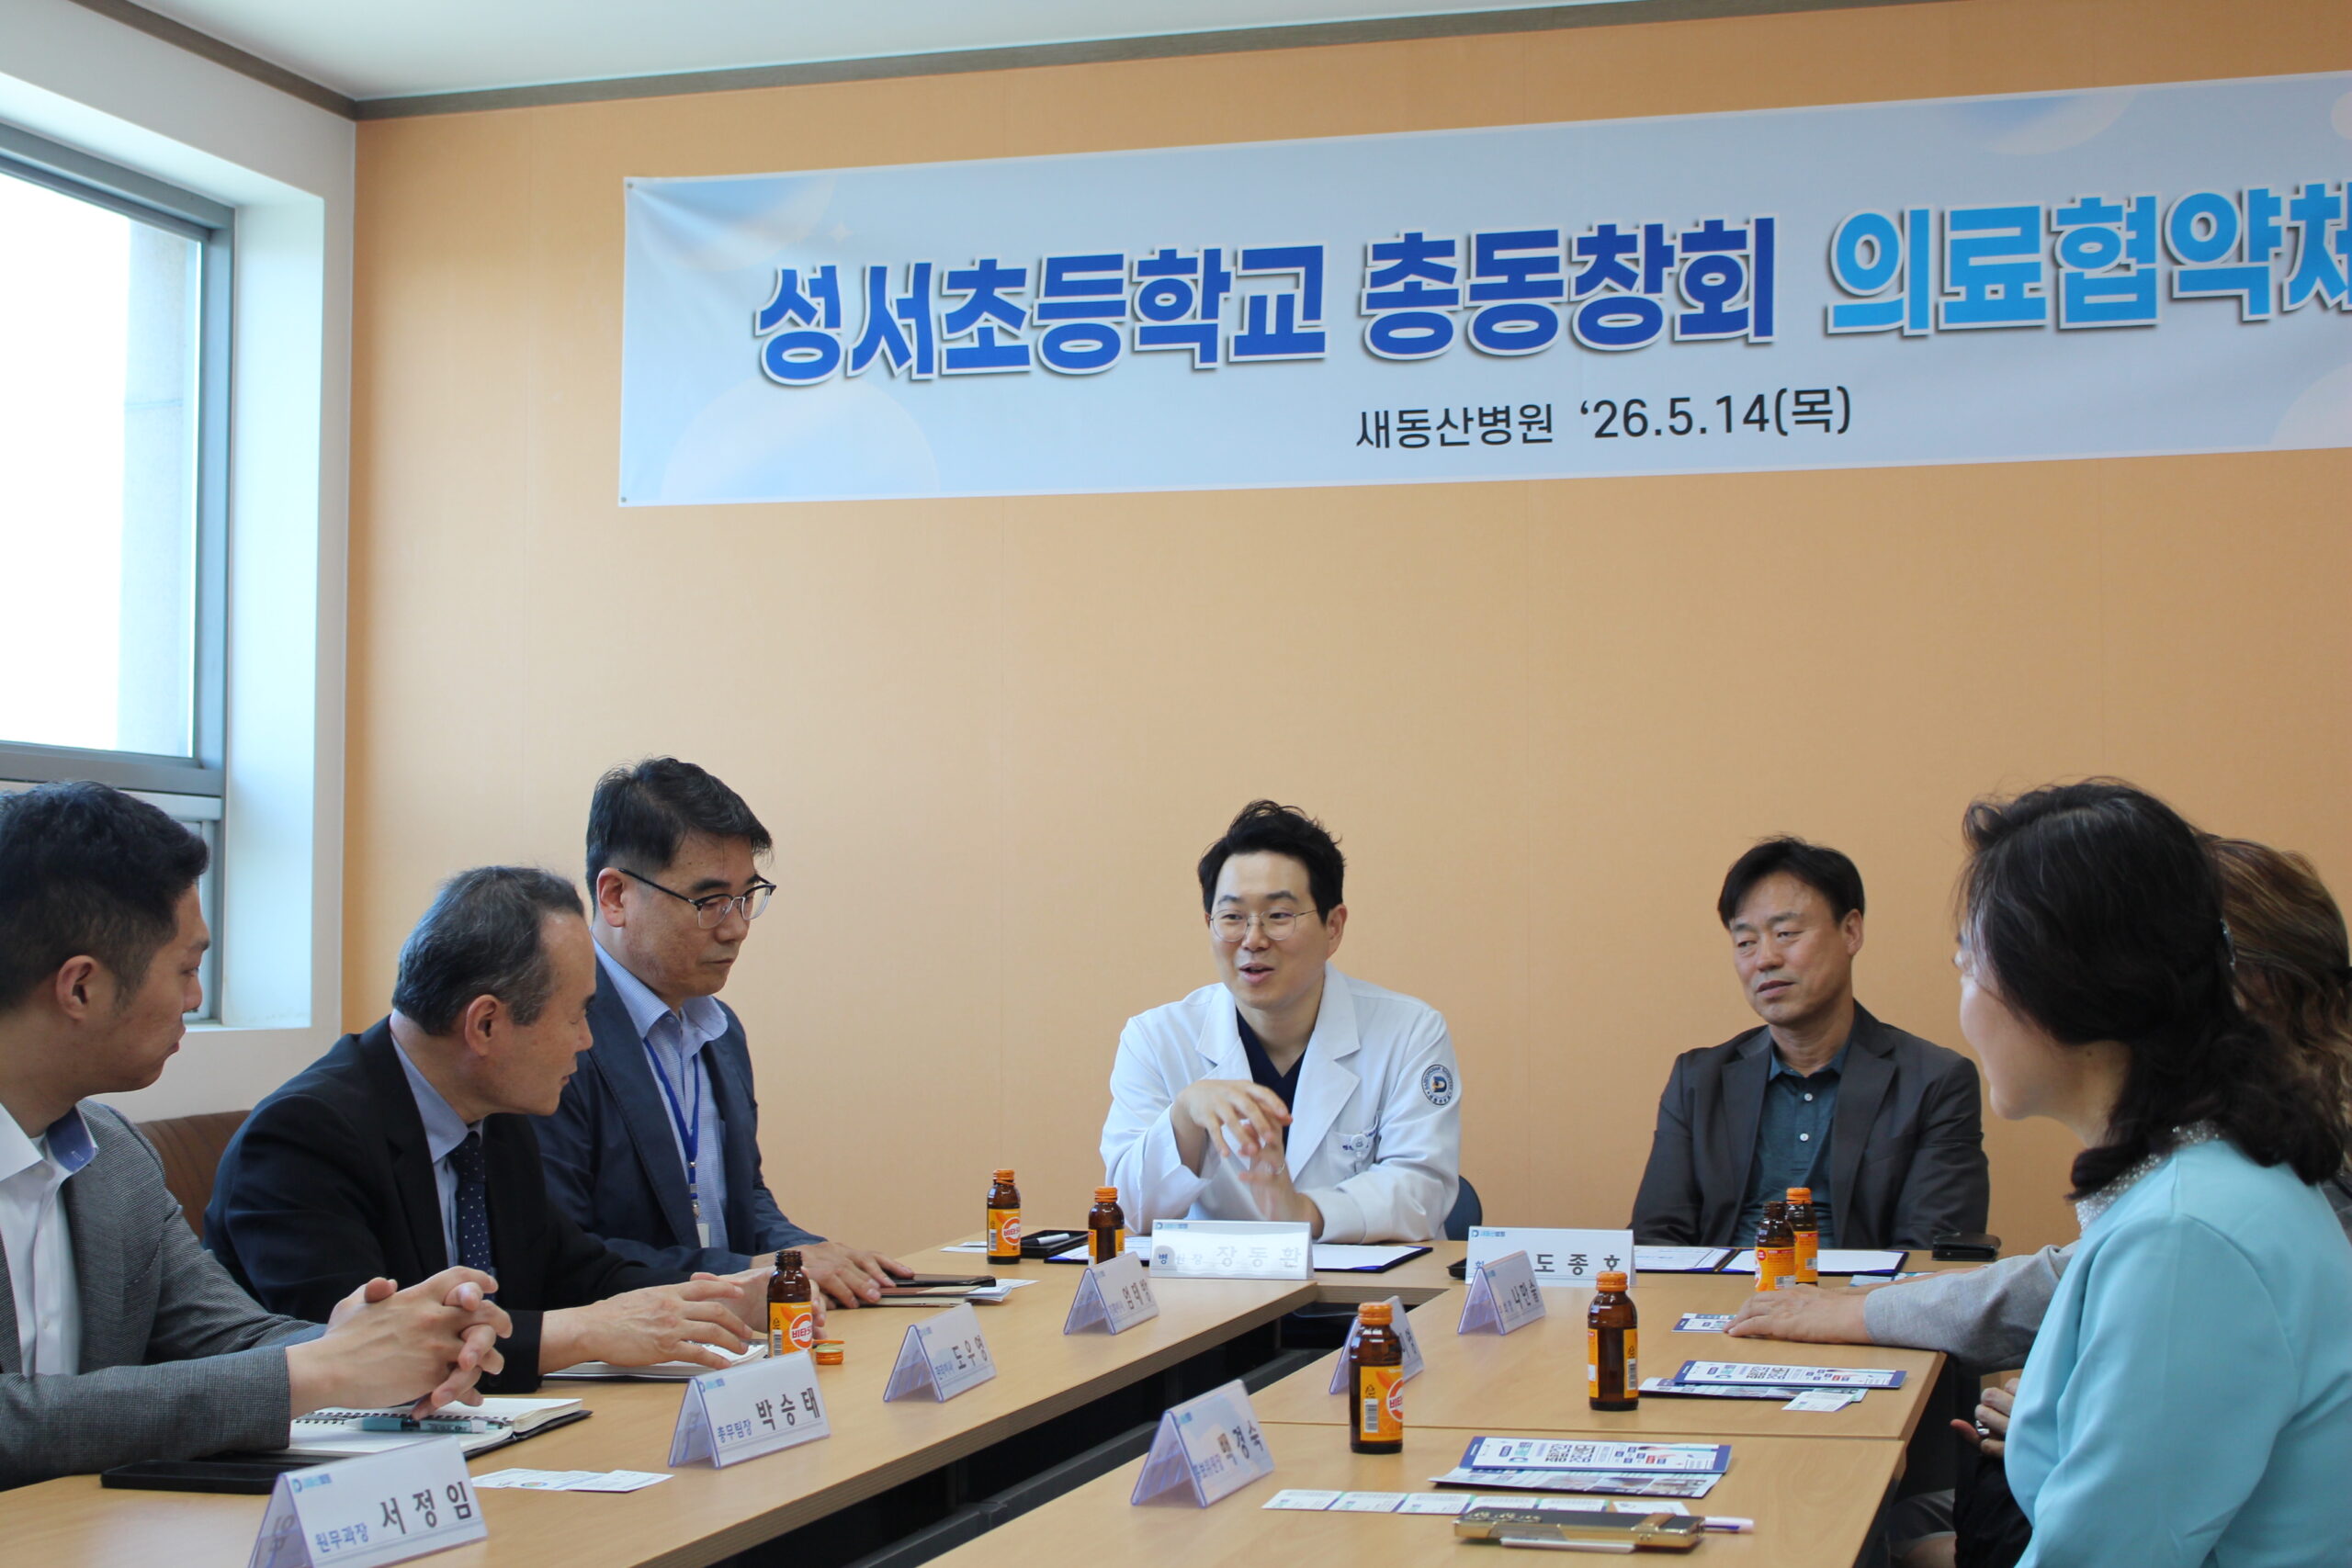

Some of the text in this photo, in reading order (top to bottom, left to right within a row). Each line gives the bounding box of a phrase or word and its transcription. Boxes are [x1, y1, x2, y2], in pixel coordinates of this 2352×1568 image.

[755, 243, 1329, 383] 성서초등학교
[1363, 216, 1777, 359] 총동창회
[1356, 402, 1554, 449] 새동산병원
[951, 1334, 989, 1371] 도우영
[717, 1387, 820, 1444] 총무팀장 박승태
[315, 1523, 369, 1553] 원무과장
[379, 1481, 473, 1535] 서정임
